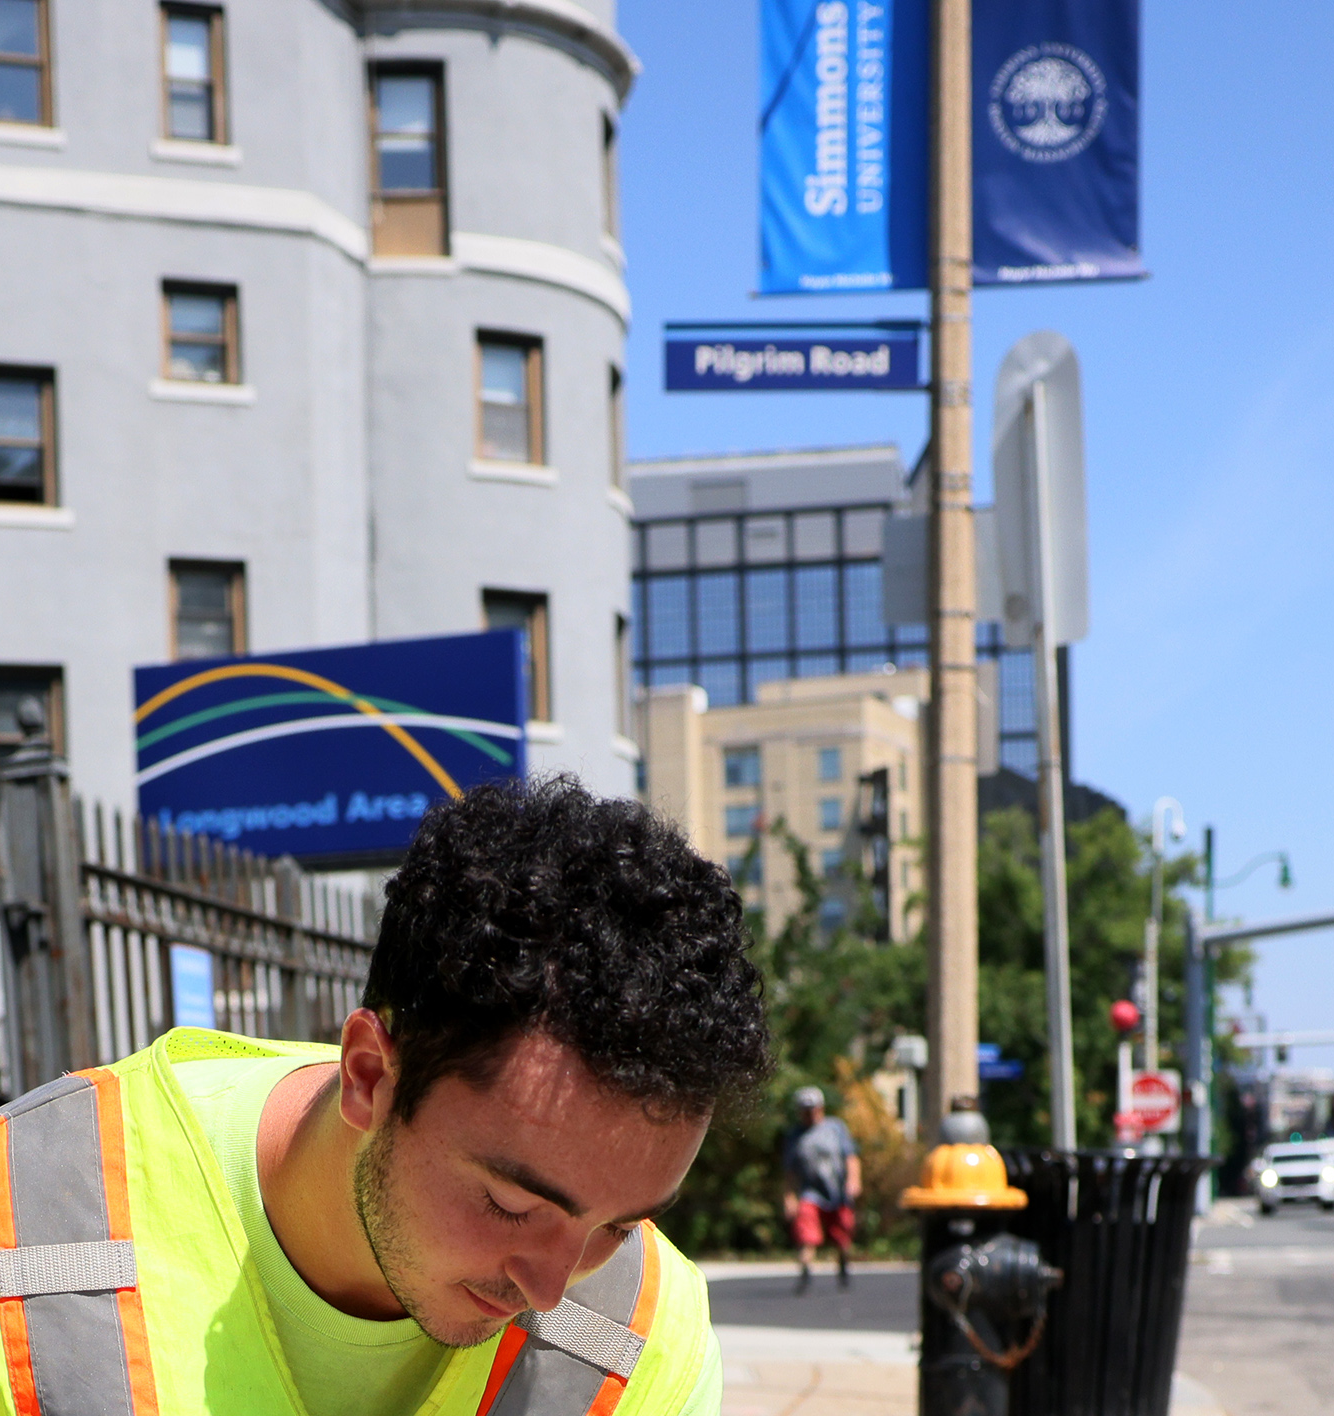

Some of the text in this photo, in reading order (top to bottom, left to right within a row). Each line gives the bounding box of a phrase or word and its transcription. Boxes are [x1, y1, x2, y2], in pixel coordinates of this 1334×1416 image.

[804, 1, 849, 217] Simmons
[855, 1, 884, 214] UNIVERSITY
[694, 344, 891, 383] Pilgrim Road
[345, 790, 429, 824] Area
